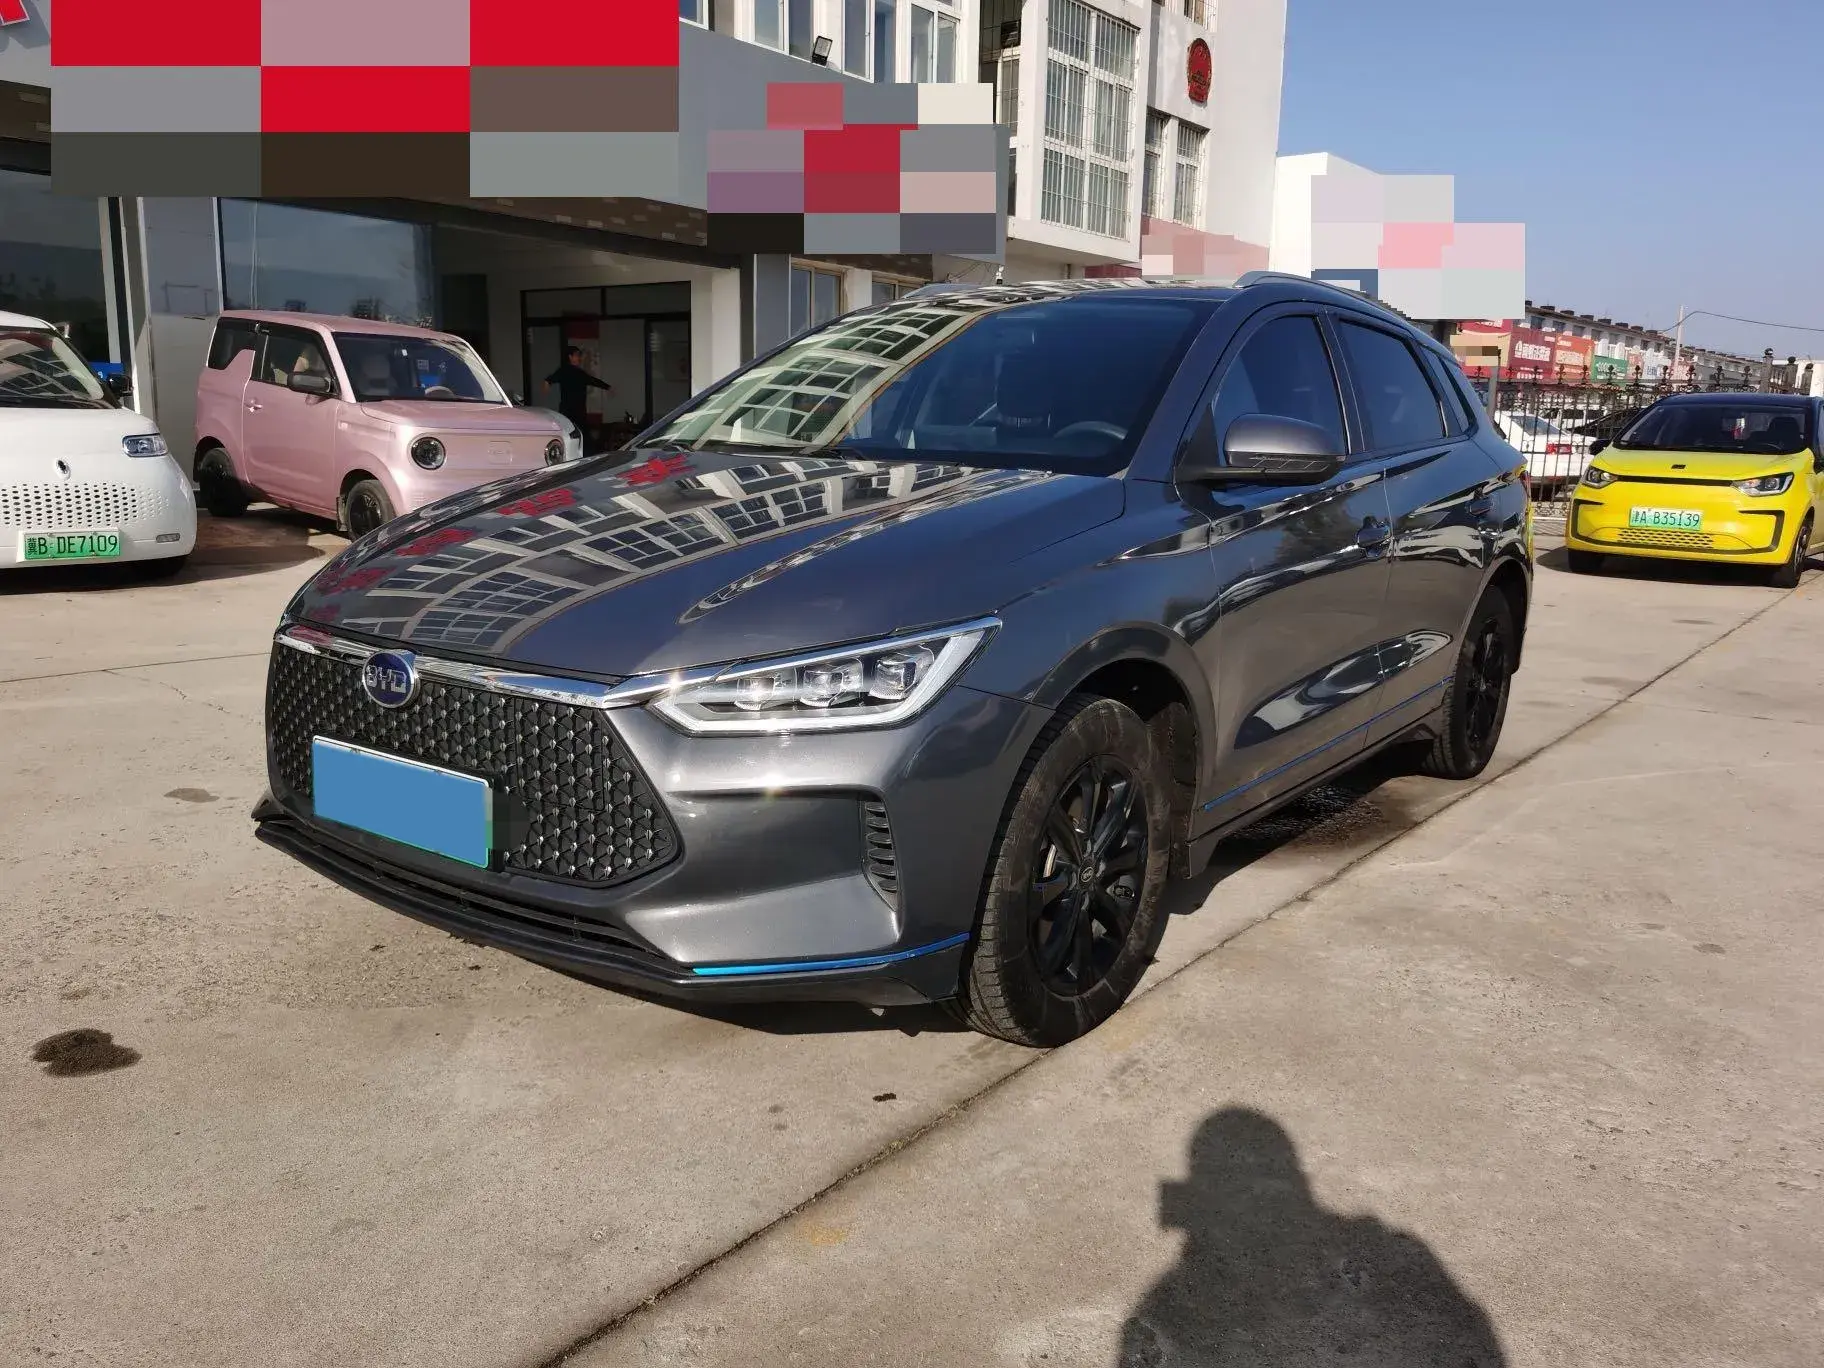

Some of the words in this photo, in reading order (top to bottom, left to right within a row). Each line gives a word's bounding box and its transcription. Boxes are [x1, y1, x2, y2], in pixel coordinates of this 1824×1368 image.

[27, 537, 48, 555] 冀B
[56, 535, 118, 554] DE7109
[366, 664, 407, 694] BYD
